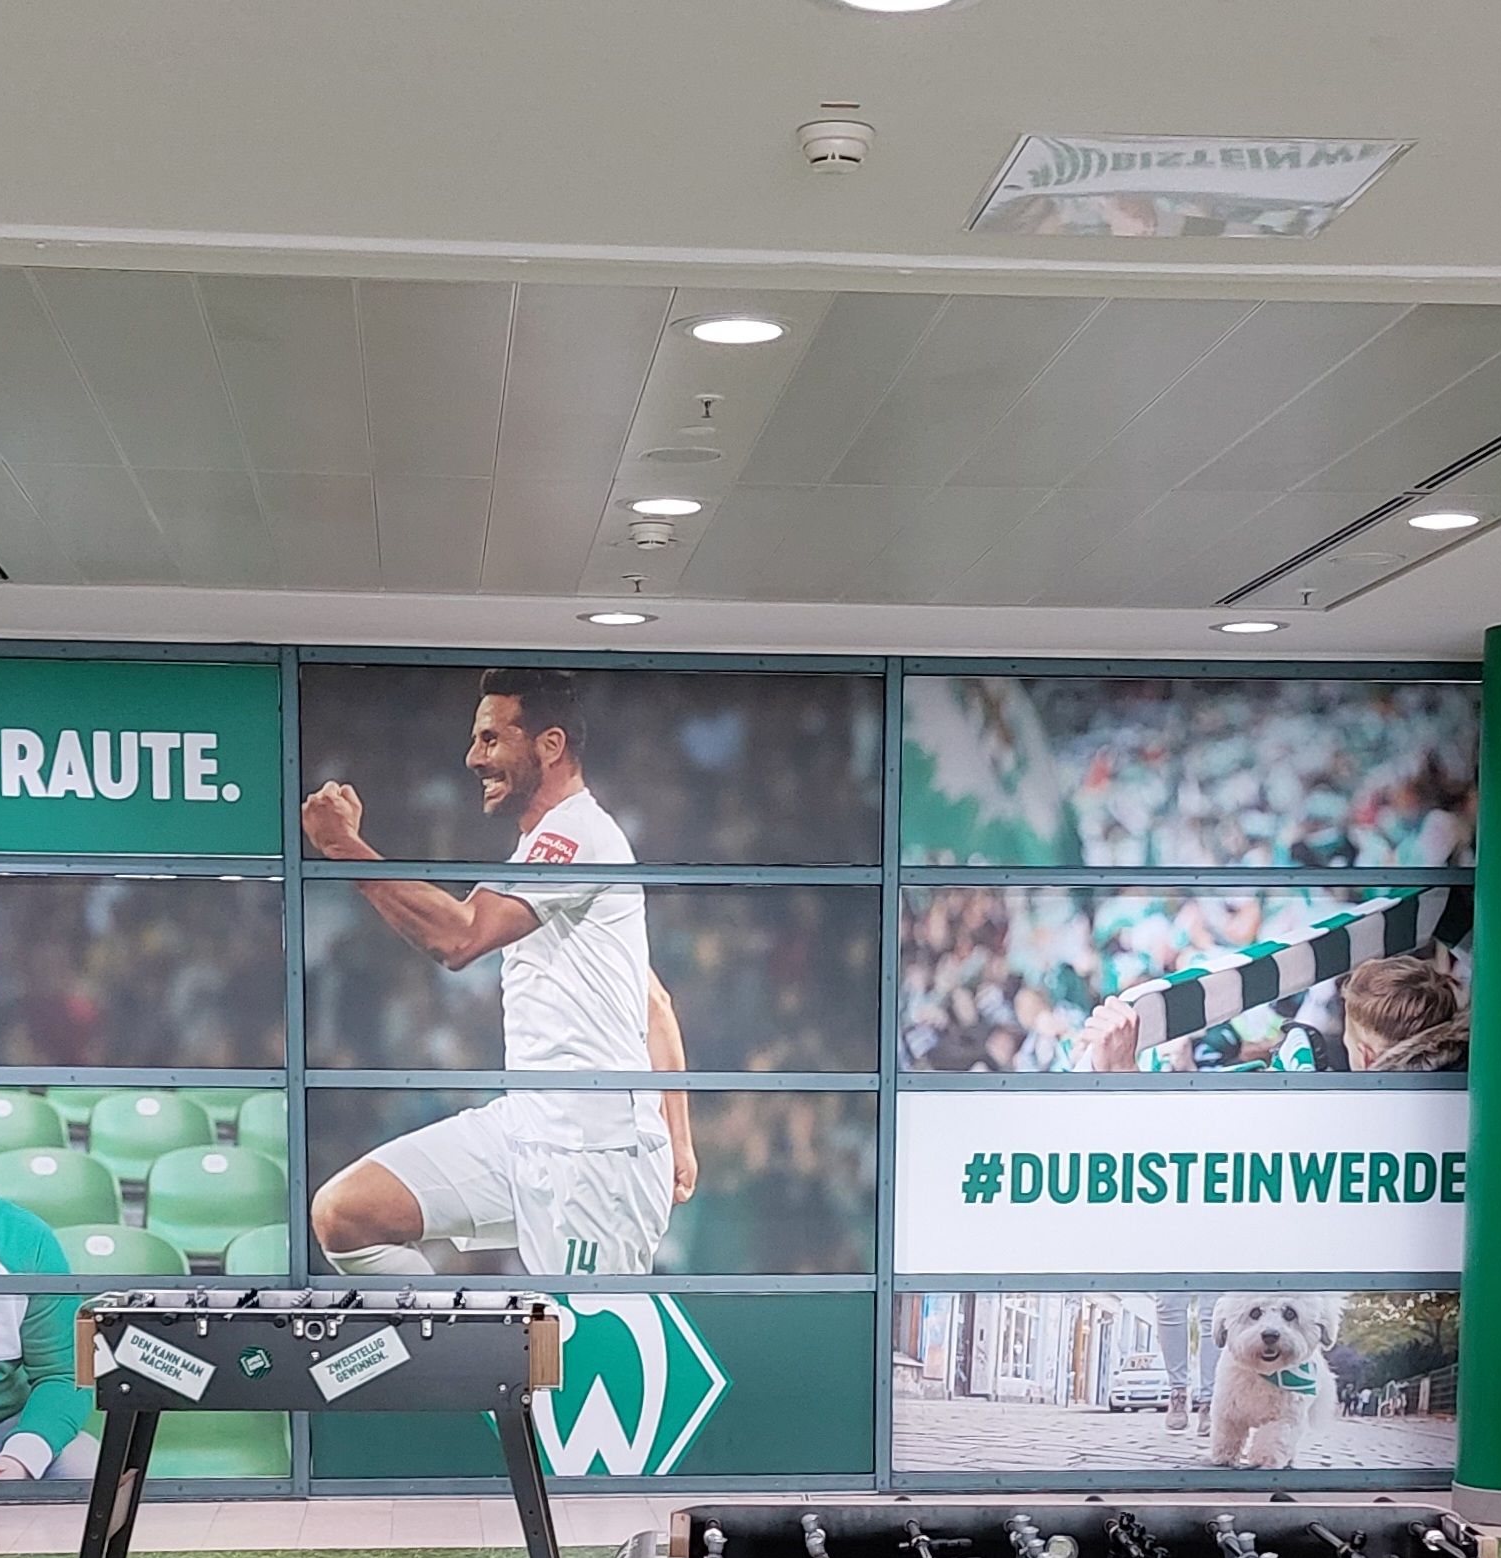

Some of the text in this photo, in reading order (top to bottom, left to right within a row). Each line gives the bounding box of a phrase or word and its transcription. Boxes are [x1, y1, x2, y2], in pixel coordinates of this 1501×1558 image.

[0, 727, 241, 802] RAUTE.
[961, 1151, 1466, 1204] #DUBISTEINWERDE
[565, 1238, 598, 1274] 14
[130, 1334, 204, 1378] DEN KANN MAN
[139, 1352, 182, 1381] MACHEN.
[326, 1337, 386, 1376] ZWEISTELLIG
